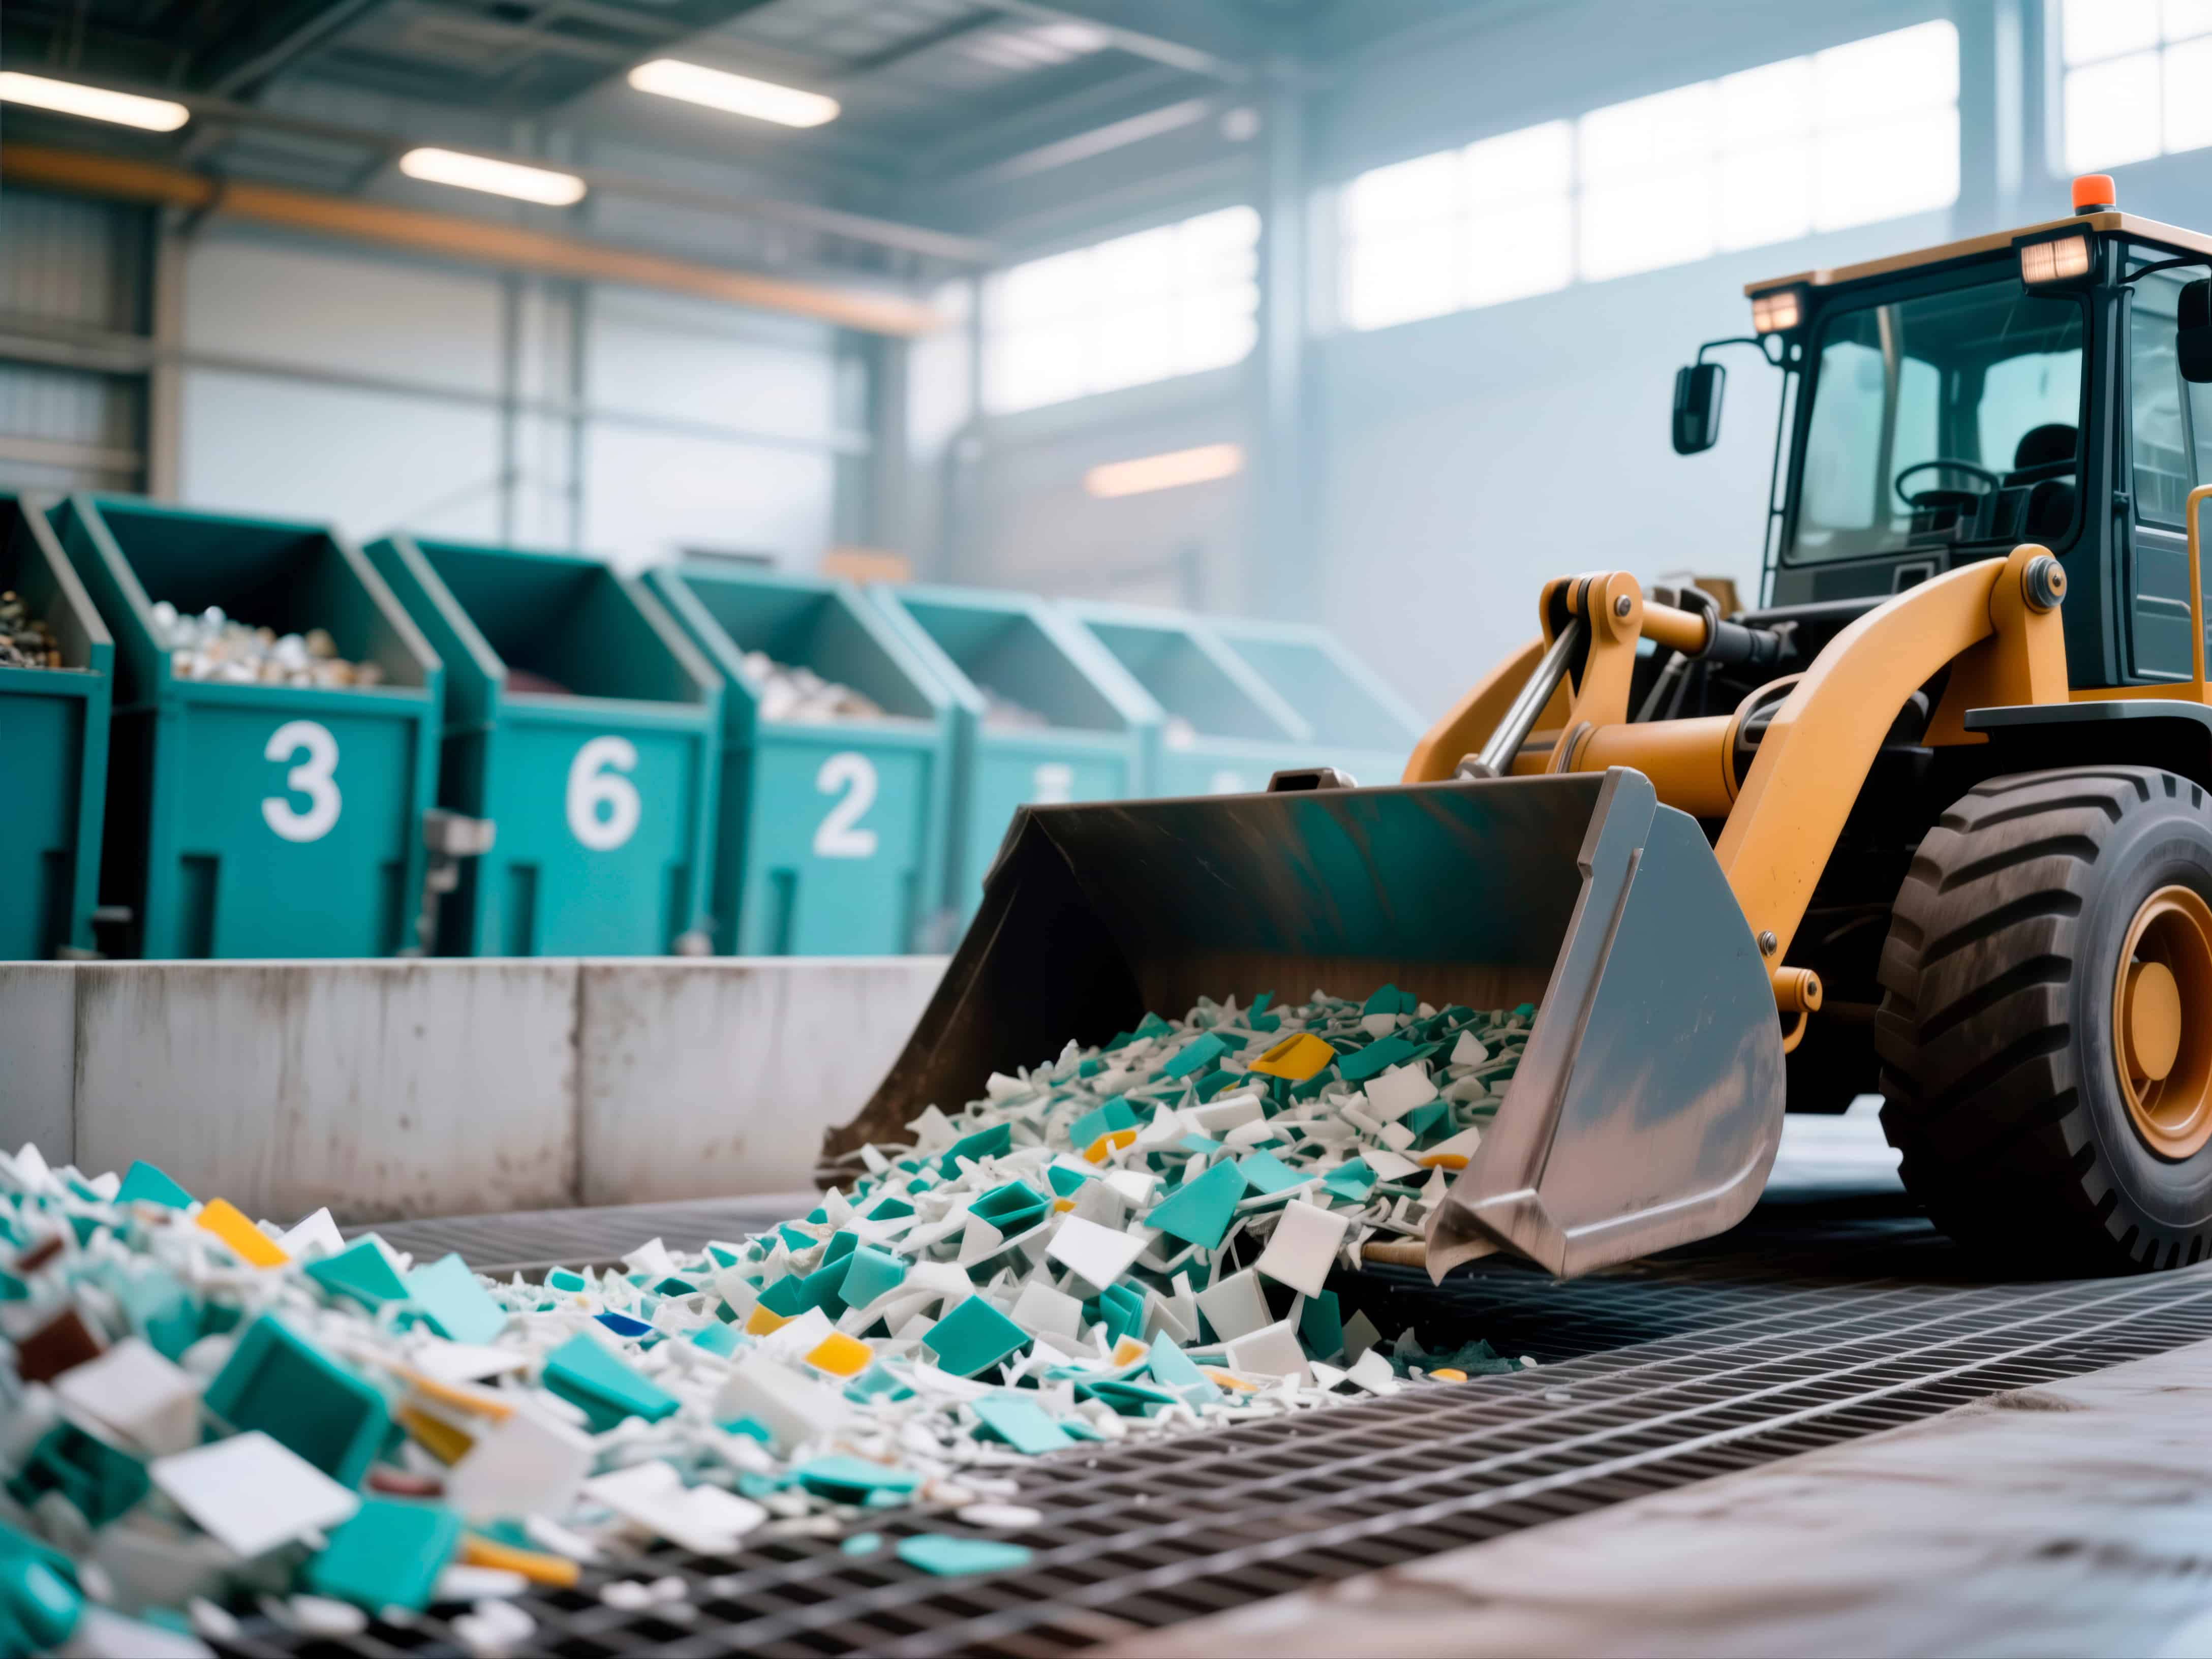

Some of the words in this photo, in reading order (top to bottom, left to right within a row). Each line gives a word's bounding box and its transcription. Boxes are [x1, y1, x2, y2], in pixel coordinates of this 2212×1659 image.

[262, 720, 342, 842] 3
[565, 735, 642, 852] 6
[813, 753, 878, 858] 2
